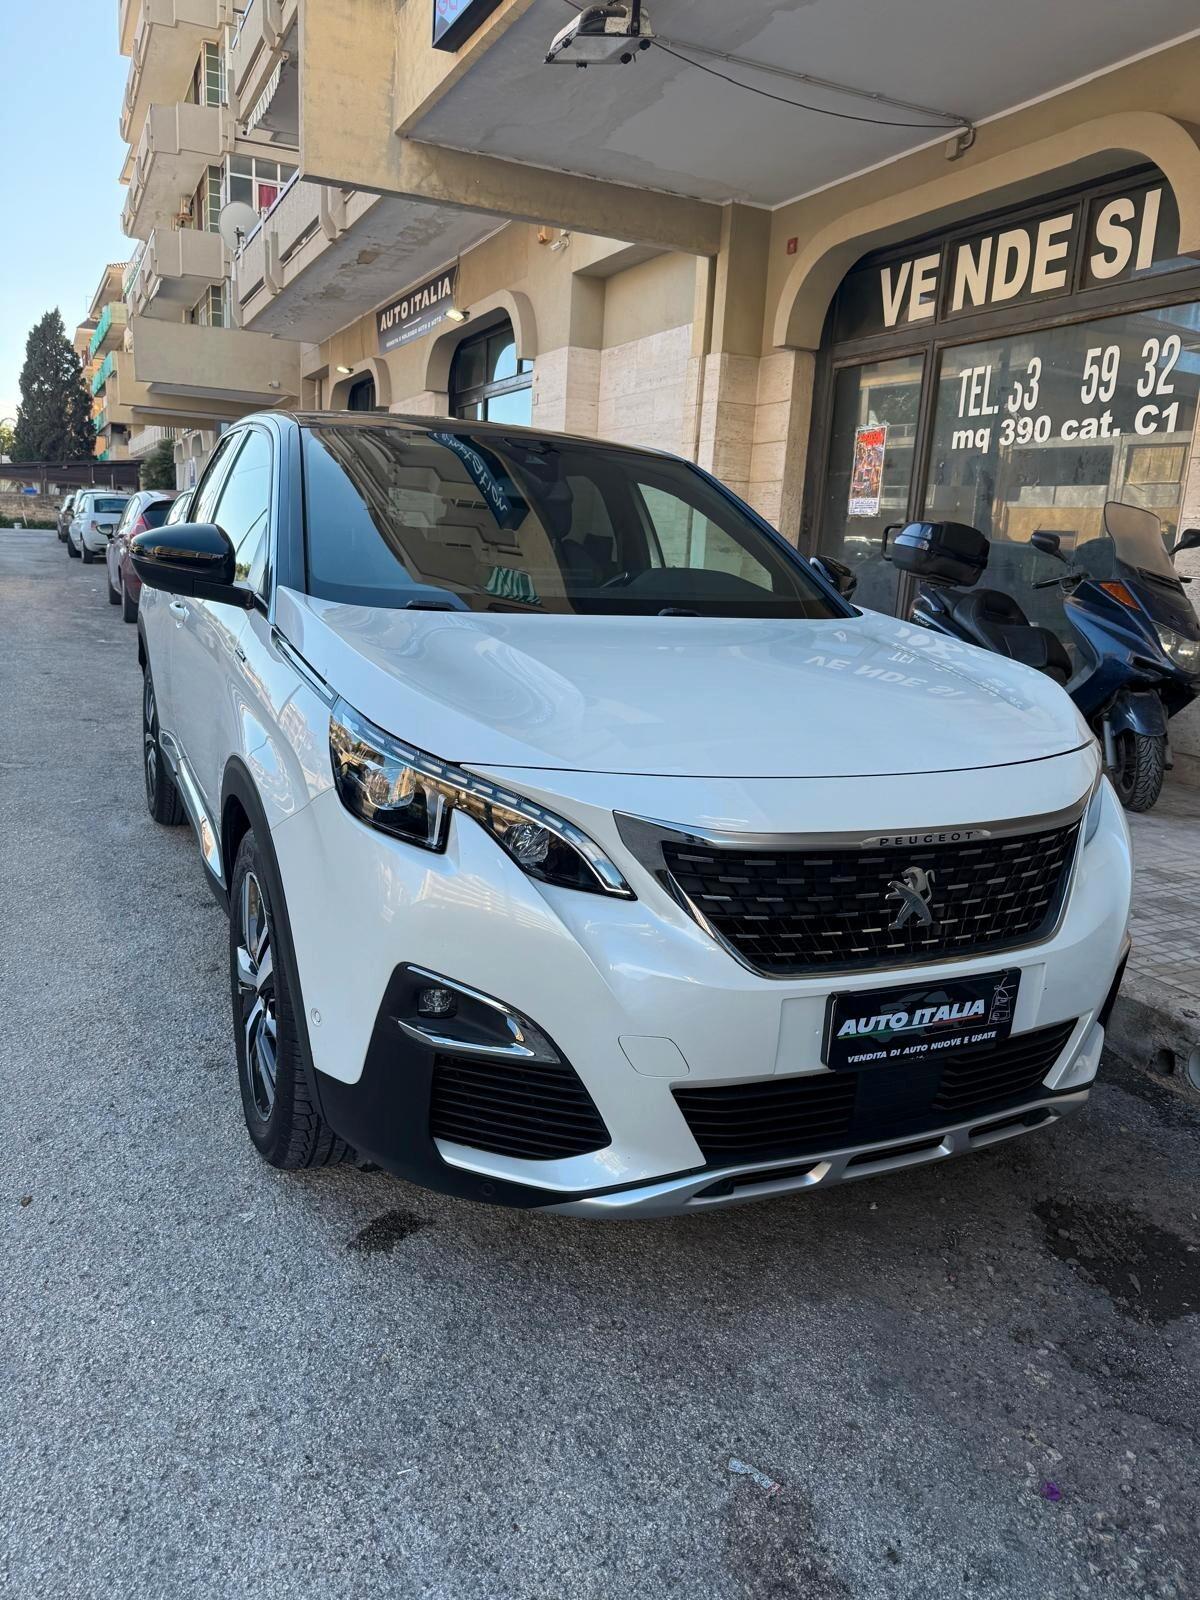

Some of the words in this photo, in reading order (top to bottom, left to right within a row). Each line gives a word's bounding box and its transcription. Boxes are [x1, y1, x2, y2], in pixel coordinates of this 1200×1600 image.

[380, 301, 408, 332] AUTO
[411, 276, 451, 315] ITALIA
[958, 365, 999, 418] TEL.
[1081, 345, 1121, 405] 59
[1137, 334, 1182, 398] 32
[951, 427, 991, 454] mq
[999, 415, 1051, 446] 390
[1060, 409, 1120, 441] cat.
[1134, 402, 1179, 436] C1
[879, 831, 974, 847] PEUGEOT
[837, 1012, 908, 1037] AUTO
[912, 999, 985, 1026] ITALIA
[847, 1050, 888, 1064] VENDITA
[890, 1049, 901, 1057] DI
[902, 1044, 928, 1055] AUTO
[930, 1038, 961, 1050] NUOVE
[971, 1031, 997, 1043] USATE
